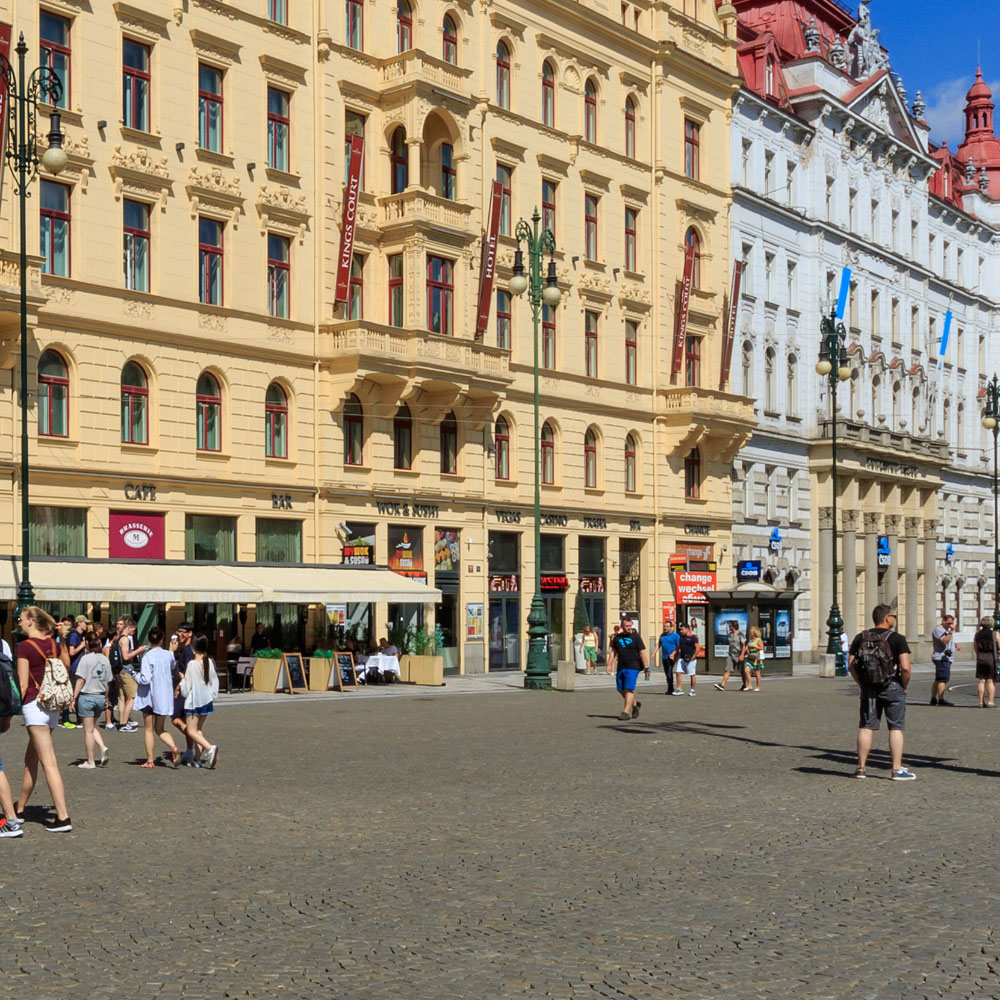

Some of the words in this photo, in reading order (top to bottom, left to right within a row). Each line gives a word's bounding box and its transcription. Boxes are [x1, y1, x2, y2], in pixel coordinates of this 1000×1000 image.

[347, 175, 358, 221] COURT
[342, 224, 353, 268] KINGS
[486, 234, 496, 278] HOTEL
[124, 484, 156, 501] CAFE
[272, 494, 292, 510] BAR
[376, 502, 400, 516] WOK
[402, 504, 410, 516] &
[412, 504, 440, 519] SUSHI
[495, 510, 521, 524] VEGAS
[118, 522, 154, 538] BRASSERIE
[684, 524, 711, 536] CHANGE
[680, 574, 712, 584] change
